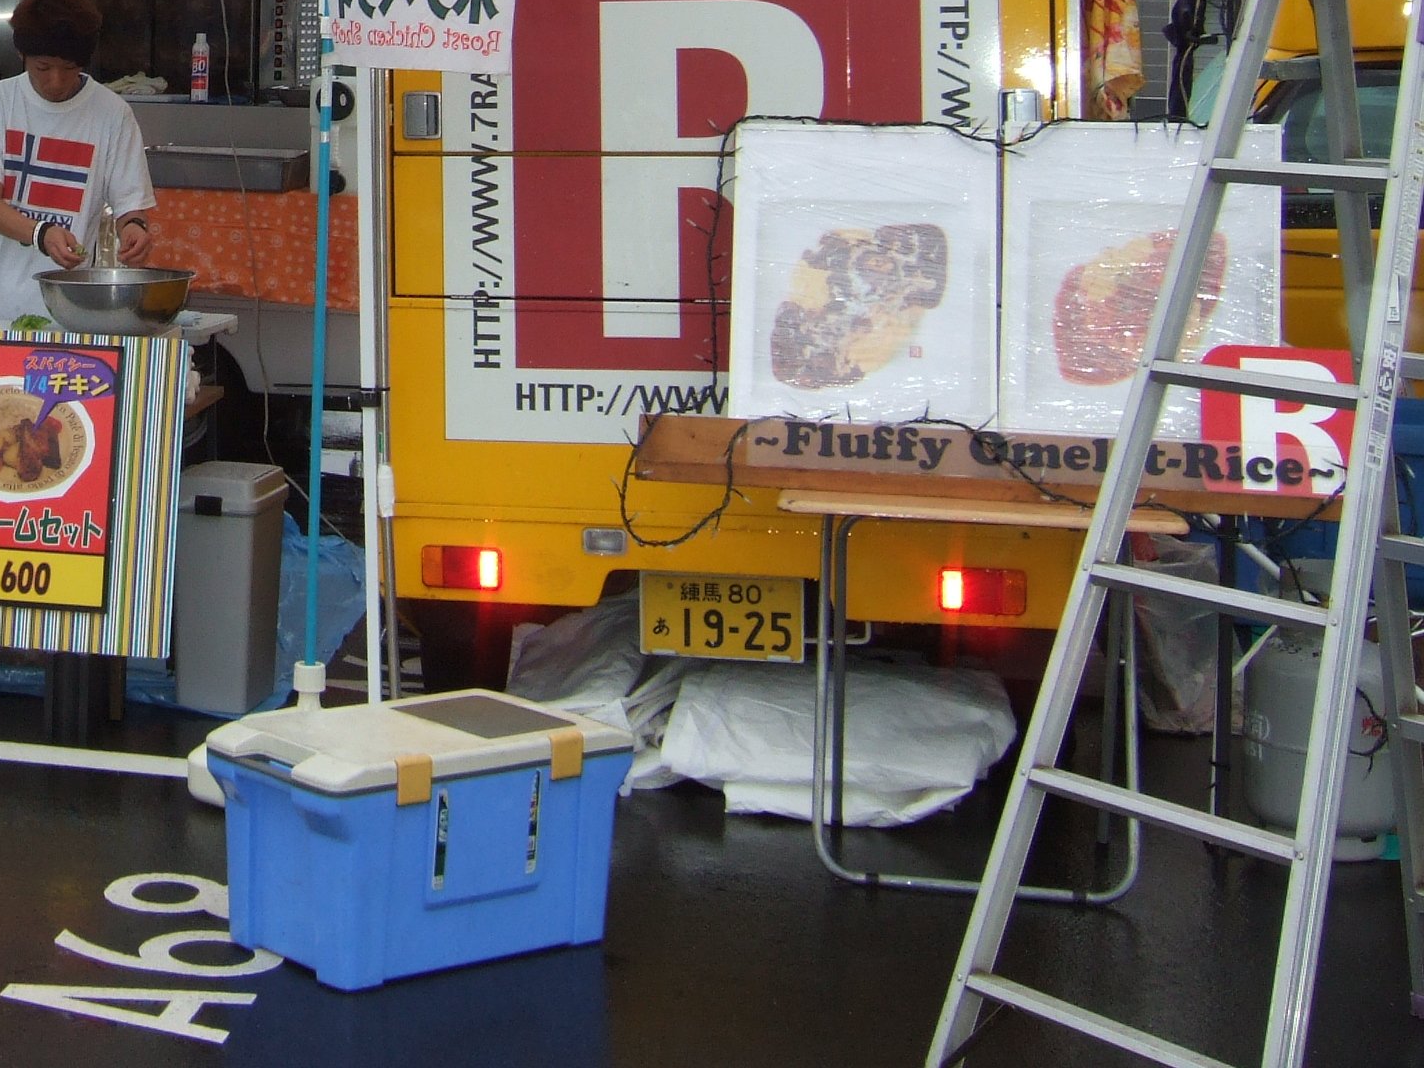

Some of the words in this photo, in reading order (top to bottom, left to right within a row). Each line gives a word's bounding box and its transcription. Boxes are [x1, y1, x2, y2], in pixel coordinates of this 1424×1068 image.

[26, 356, 96, 371] スパイシー
[1240, 357, 1345, 493] R
[729, 584, 762, 604] 80
[653, 617, 670, 636] あ
[684, 608, 792, 652] 19-25
